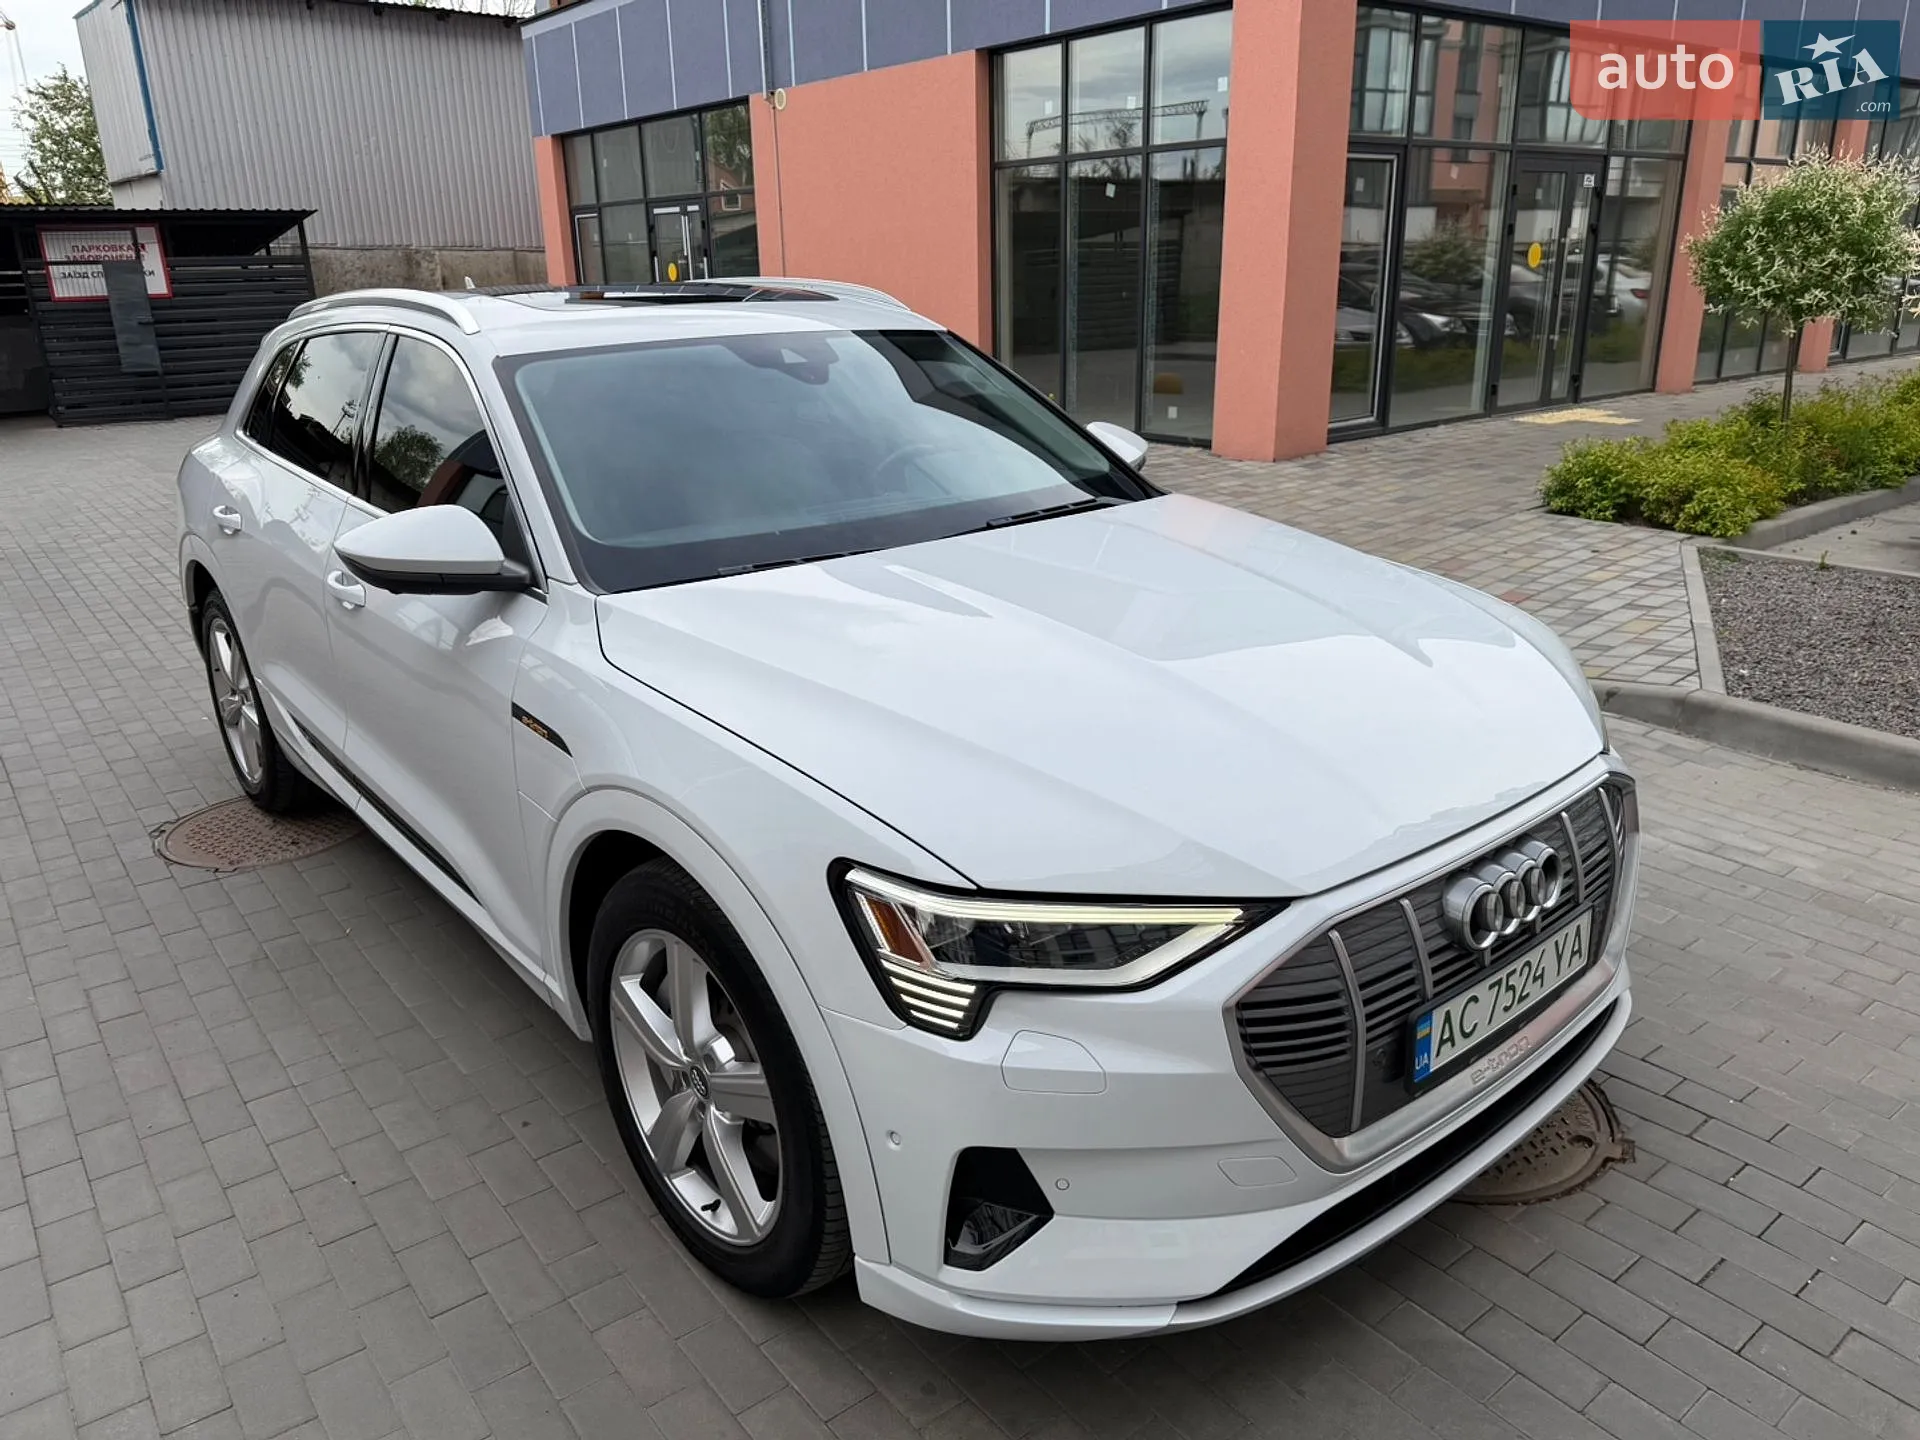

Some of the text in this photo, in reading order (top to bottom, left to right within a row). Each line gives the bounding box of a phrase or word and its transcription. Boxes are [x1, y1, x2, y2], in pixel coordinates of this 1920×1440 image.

[71, 243, 135, 253] ПАРКОВКА
[1435, 924, 1583, 1058] AC 7524 YA
[1415, 1052, 1429, 1070] UA
